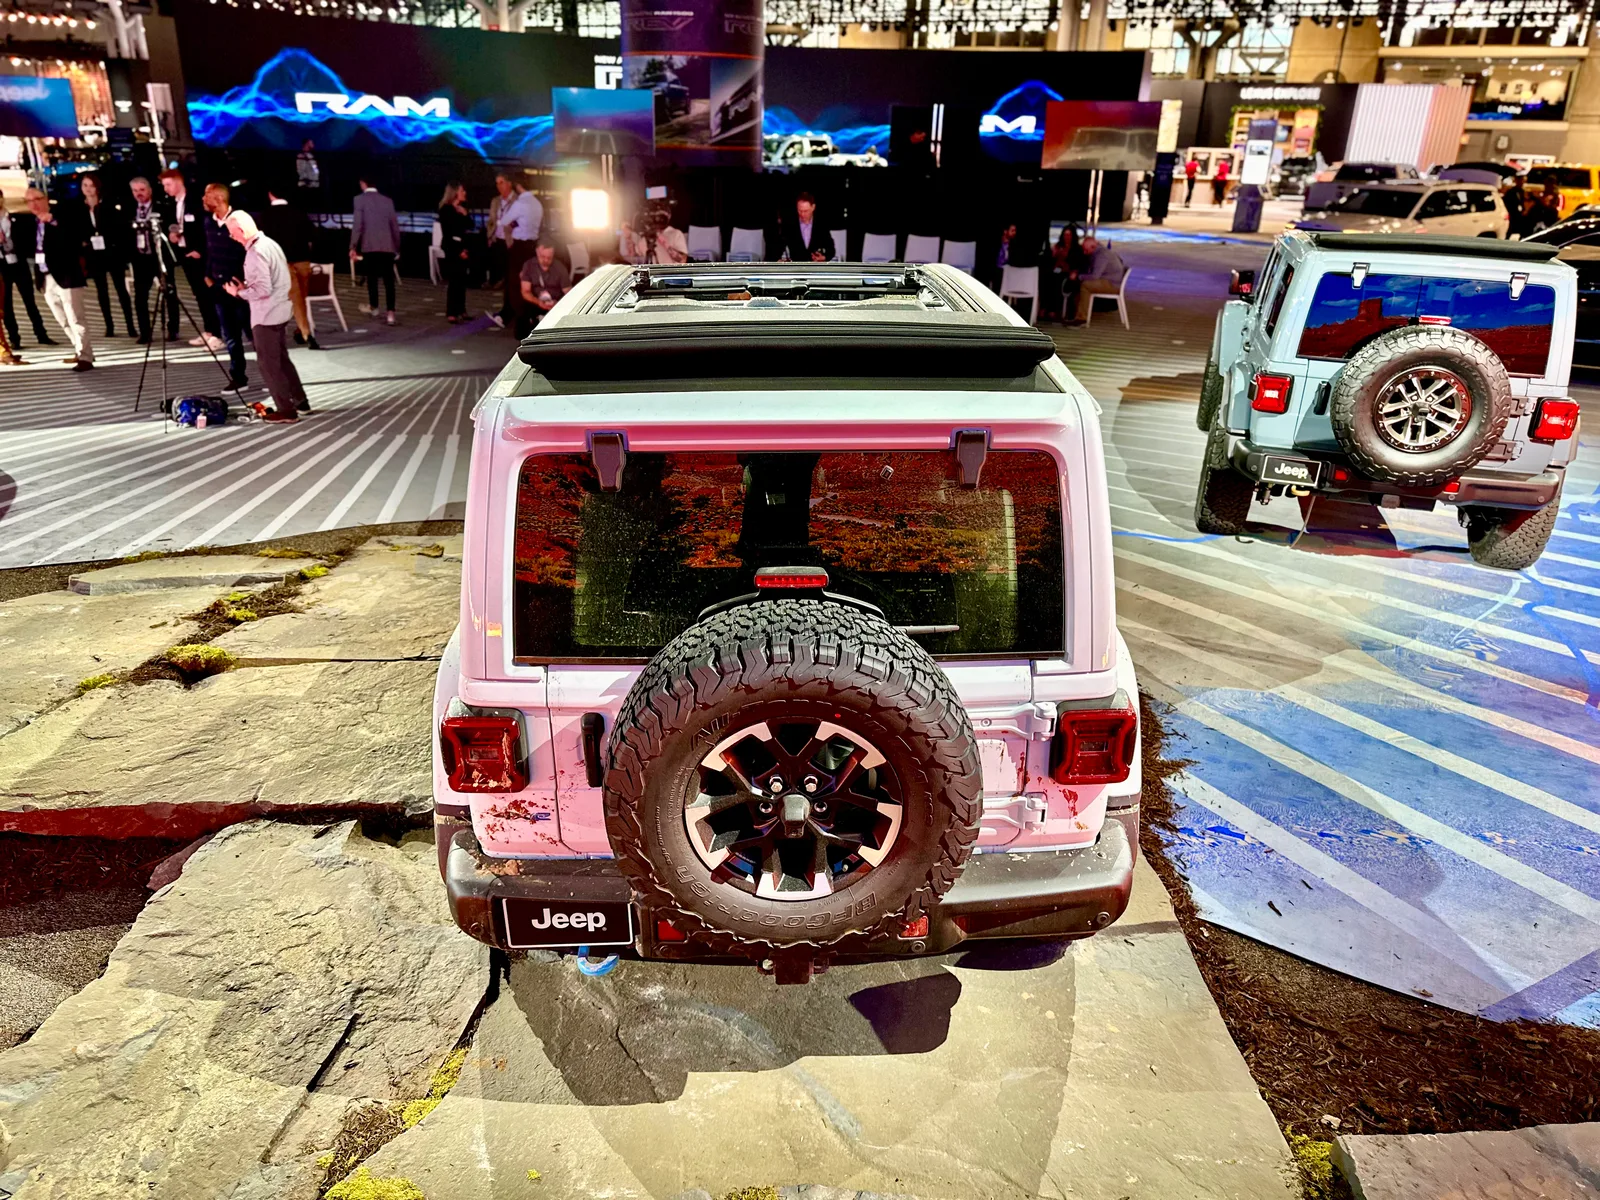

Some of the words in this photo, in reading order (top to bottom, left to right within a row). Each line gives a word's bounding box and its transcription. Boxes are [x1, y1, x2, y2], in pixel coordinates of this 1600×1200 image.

[295, 92, 450, 118] RAM
[979, 114, 1037, 134] M
[1274, 462, 1309, 480] Jeep
[675, 865, 878, 930] BFGoodrich
[531, 907, 607, 932] Jeep
